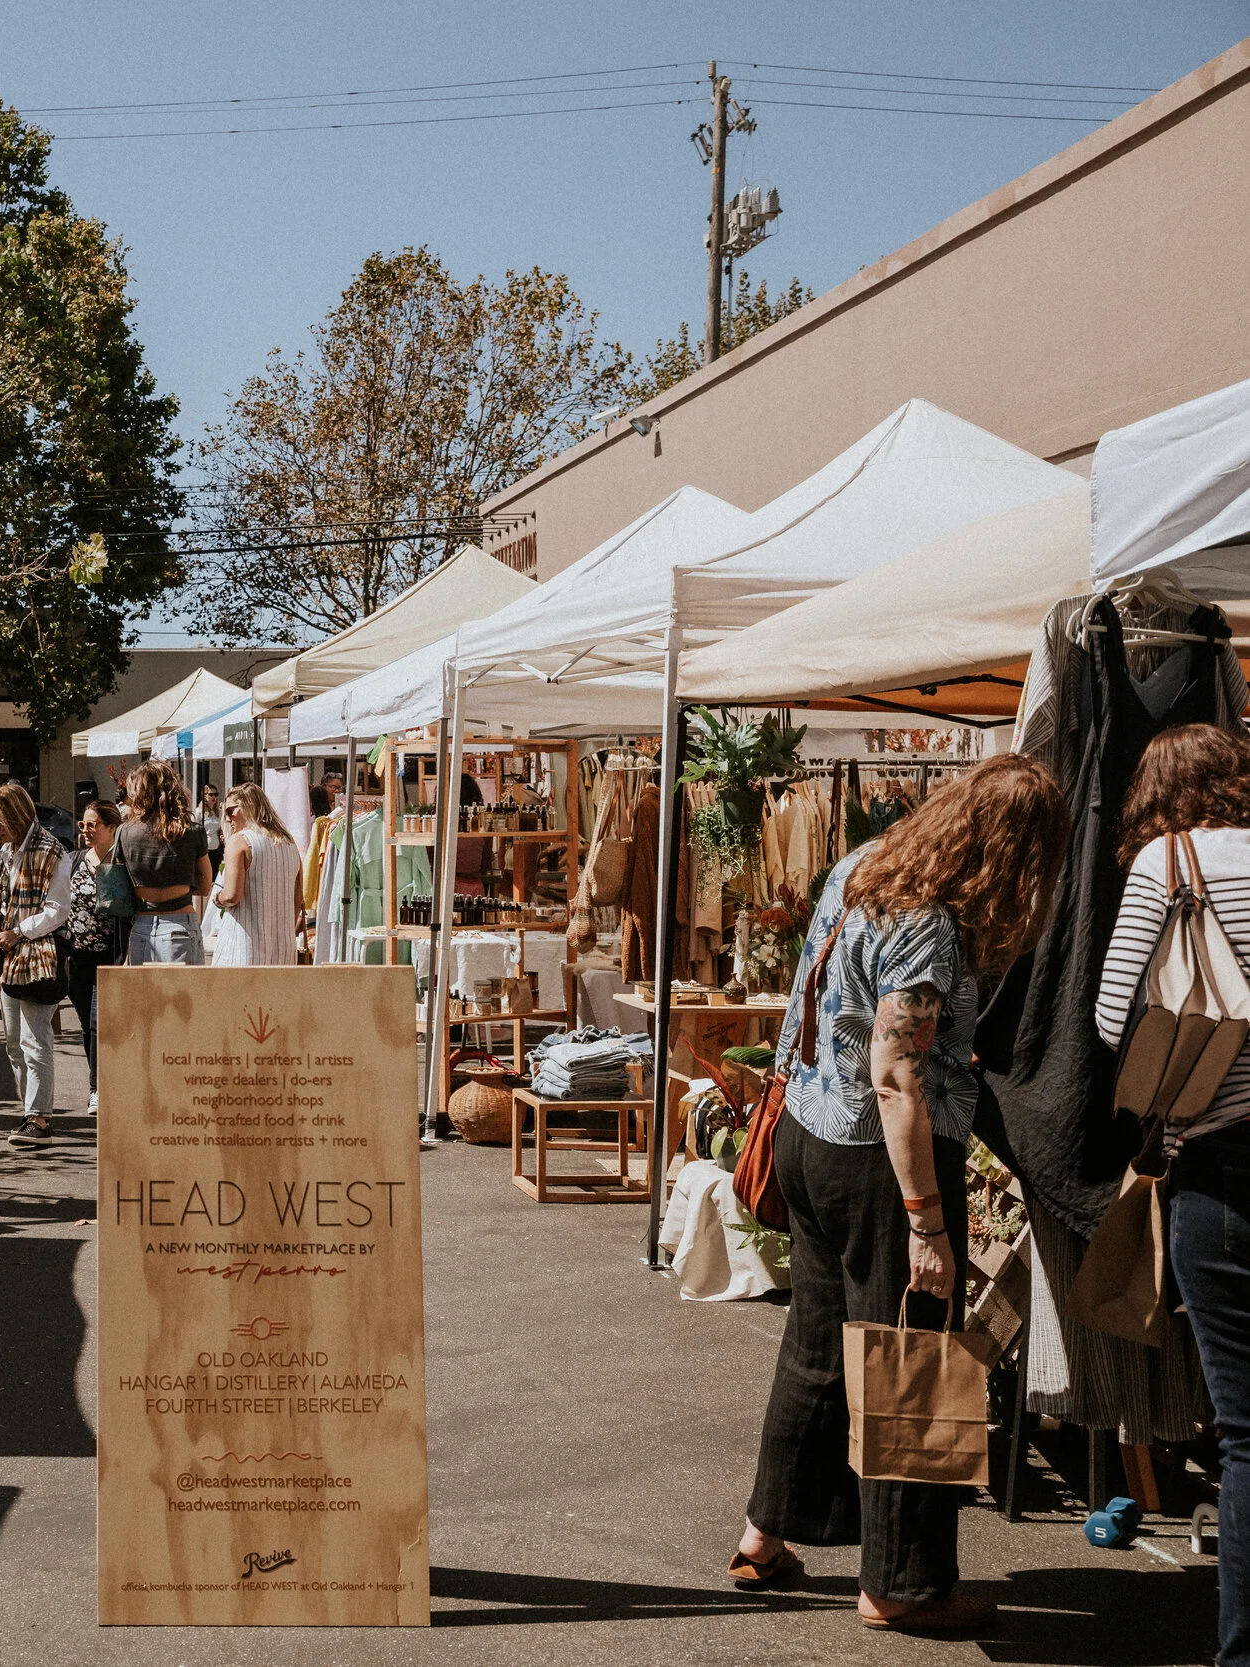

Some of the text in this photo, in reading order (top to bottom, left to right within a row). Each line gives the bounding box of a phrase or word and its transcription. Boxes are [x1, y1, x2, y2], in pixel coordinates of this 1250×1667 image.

[162, 1052, 191, 1066] local
[196, 1052, 241, 1066] makers
[254, 1053, 302, 1066] crafters
[314, 1054, 354, 1066] artists
[184, 1074, 229, 1089] vintage
[233, 1073, 278, 1086] dealers
[290, 1073, 332, 1086] do-ers
[192, 1093, 324, 1109] neighborhood shops
[171, 1113, 260, 1128] locally-crafted
[264, 1113, 294, 1126] food
[312, 1113, 345, 1126] drink
[149, 1134, 200, 1147] creative
[203, 1133, 272, 1147] installation
[275, 1134, 314, 1147] artists
[332, 1136, 368, 1147] more
[117, 1180, 406, 1228] HEAD WEST
[146, 1243, 376, 1255] A NEW MONTHLY MARKETPLACE BY
[176, 1259, 258, 1282] west
[197, 1351, 329, 1368] OLD OAKLAND
[119, 1375, 197, 1391] HANGAR
[202, 1376, 209, 1391] 1
[215, 1375, 308, 1391] DISTILLERY
[320, 1374, 408, 1391] ALAMEDA
[146, 1398, 217, 1414] FOURTH
[222, 1398, 284, 1414] STREET
[297, 1397, 383, 1413] BERKELEY
[176, 1473, 352, 1492] @headwestmarketplace
[168, 1497, 361, 1514] headwestmarketplace.com
[1095, 1526, 1106, 1538] 5
[242, 1549, 296, 1577] Revive
[150, 1581, 193, 1592] kombucha
[195, 1583, 229, 1593] sponsor
[231, 1581, 242, 1592] of
[243, 1581, 270, 1592] HEAD
[271, 1581, 299, 1591] WEST
[301, 1582, 309, 1591] at
[330, 1581, 366, 1591] Oakland
[376, 1581, 407, 1593] Hangar
[409, 1582, 414, 1590] 1
